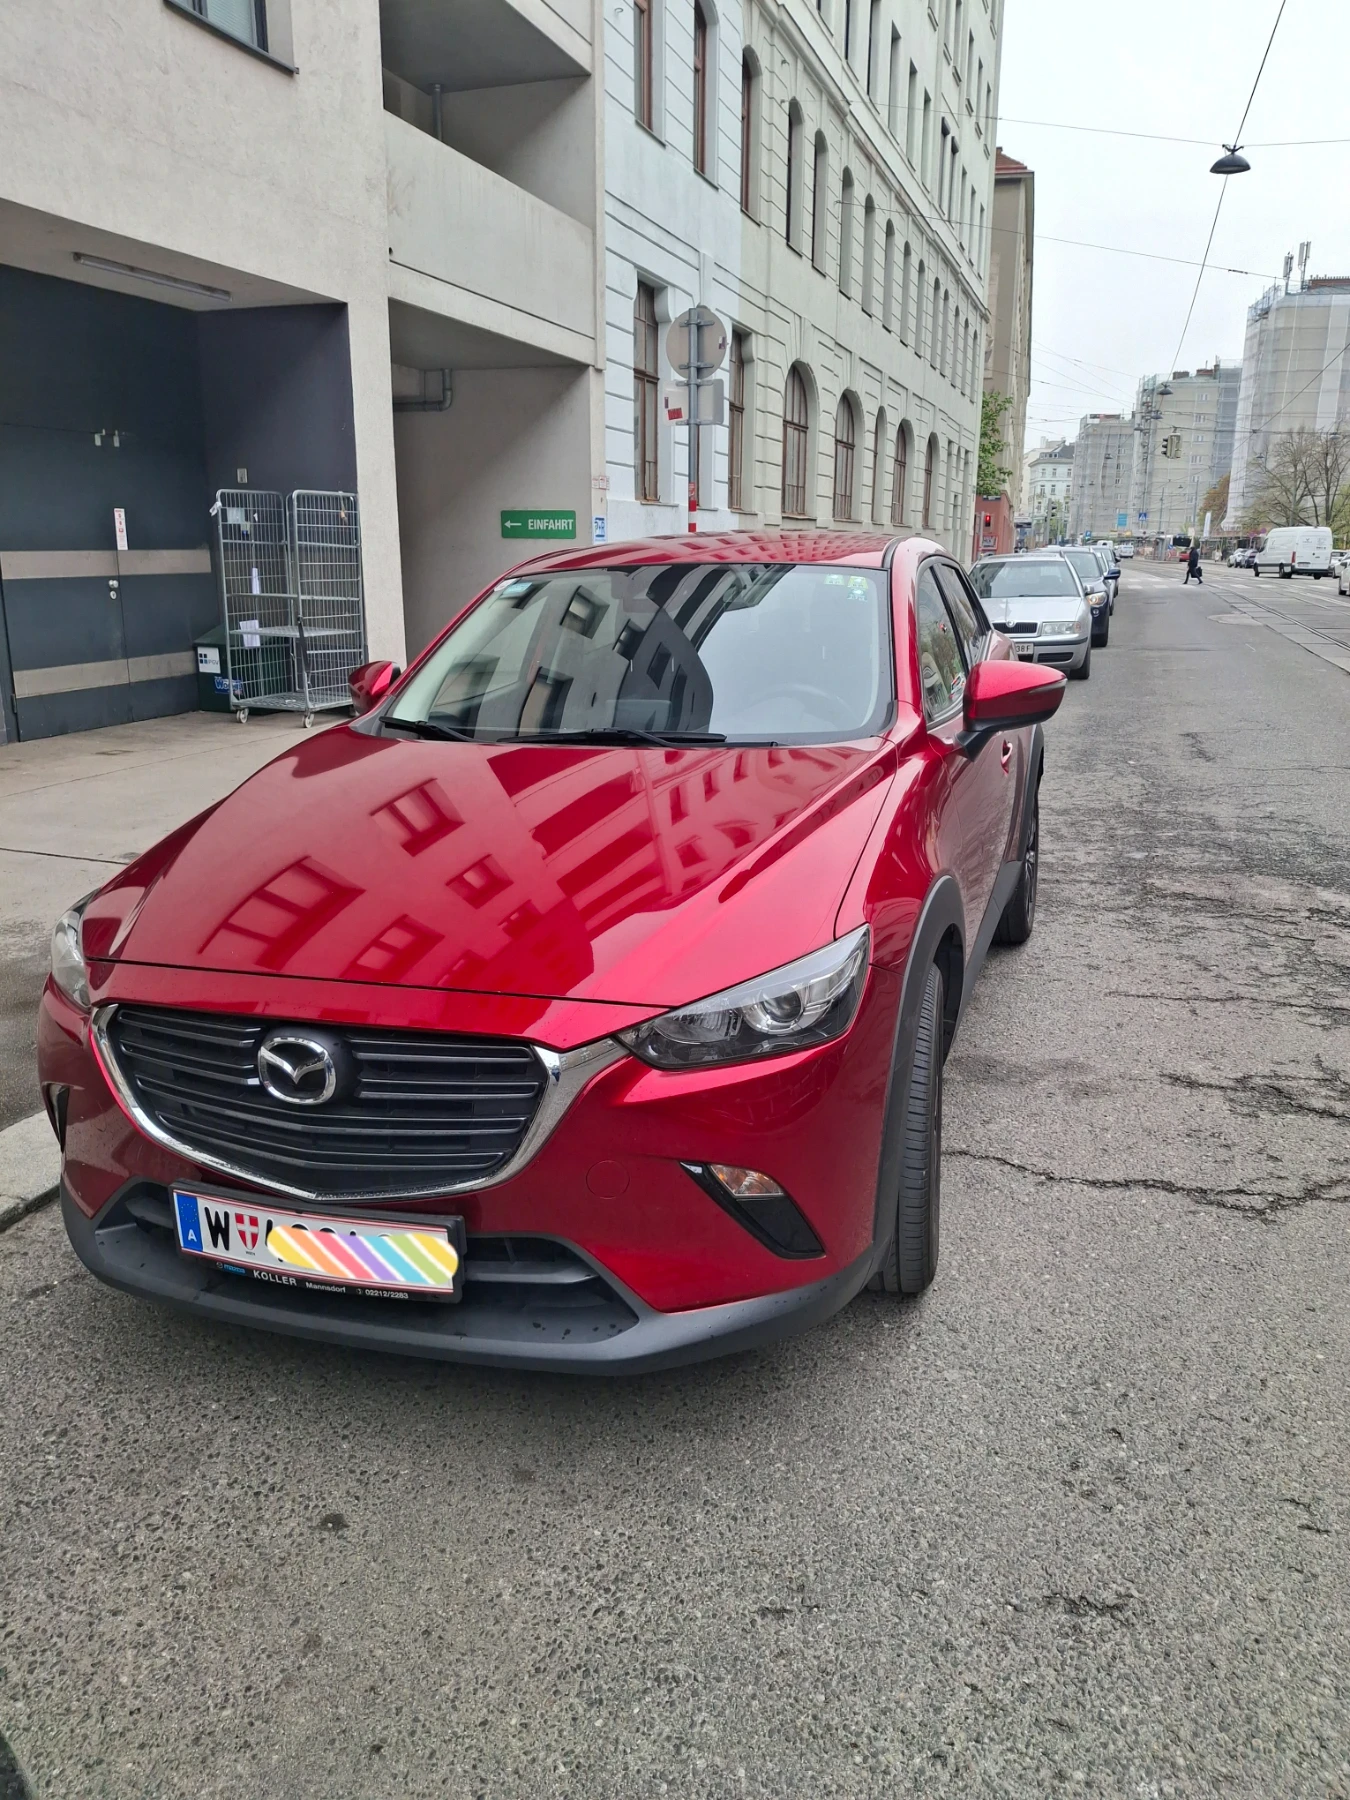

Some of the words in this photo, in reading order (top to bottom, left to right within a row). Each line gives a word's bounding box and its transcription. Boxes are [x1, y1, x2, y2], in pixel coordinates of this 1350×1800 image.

[528, 519, 573, 530] EINFAHRT
[187, 1228, 198, 1242] A
[204, 1206, 230, 1252] W
[253, 1269, 298, 1287] KOLLER
[305, 1281, 346, 1293] Mannsdorf
